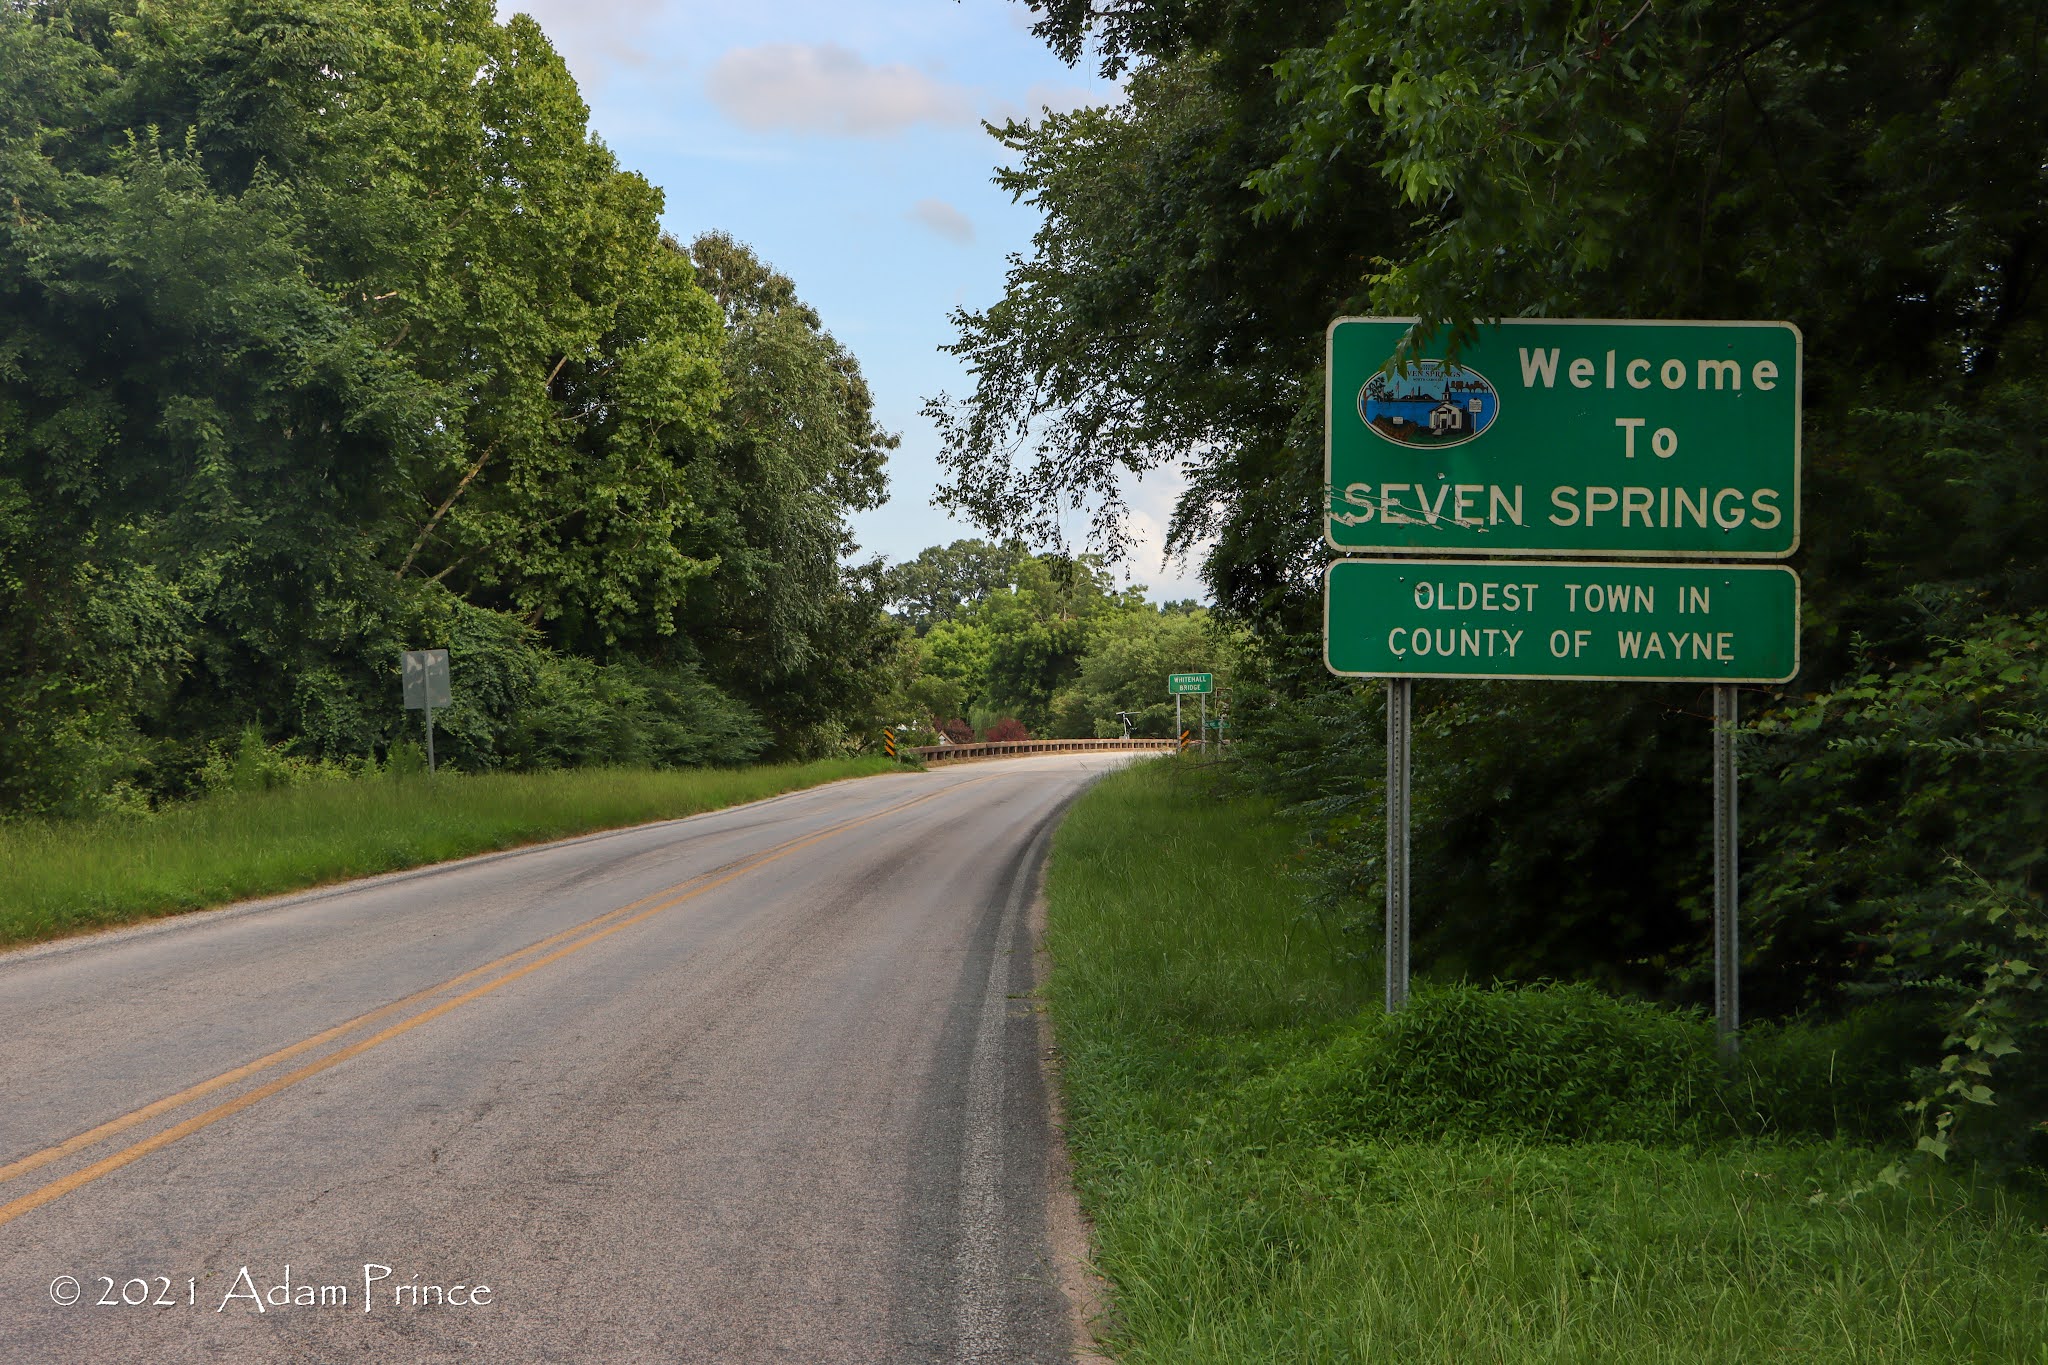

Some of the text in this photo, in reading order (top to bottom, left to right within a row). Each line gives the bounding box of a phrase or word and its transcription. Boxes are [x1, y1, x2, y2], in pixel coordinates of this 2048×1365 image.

[1518, 347, 1779, 391] Welcome
[1615, 417, 1678, 459] To
[1345, 482, 1782, 530] SEVEN SPRINGS
[1414, 581, 1710, 614] OLDEST TOWN IN
[1388, 627, 1735, 661] COUNTY OF WAYNE
